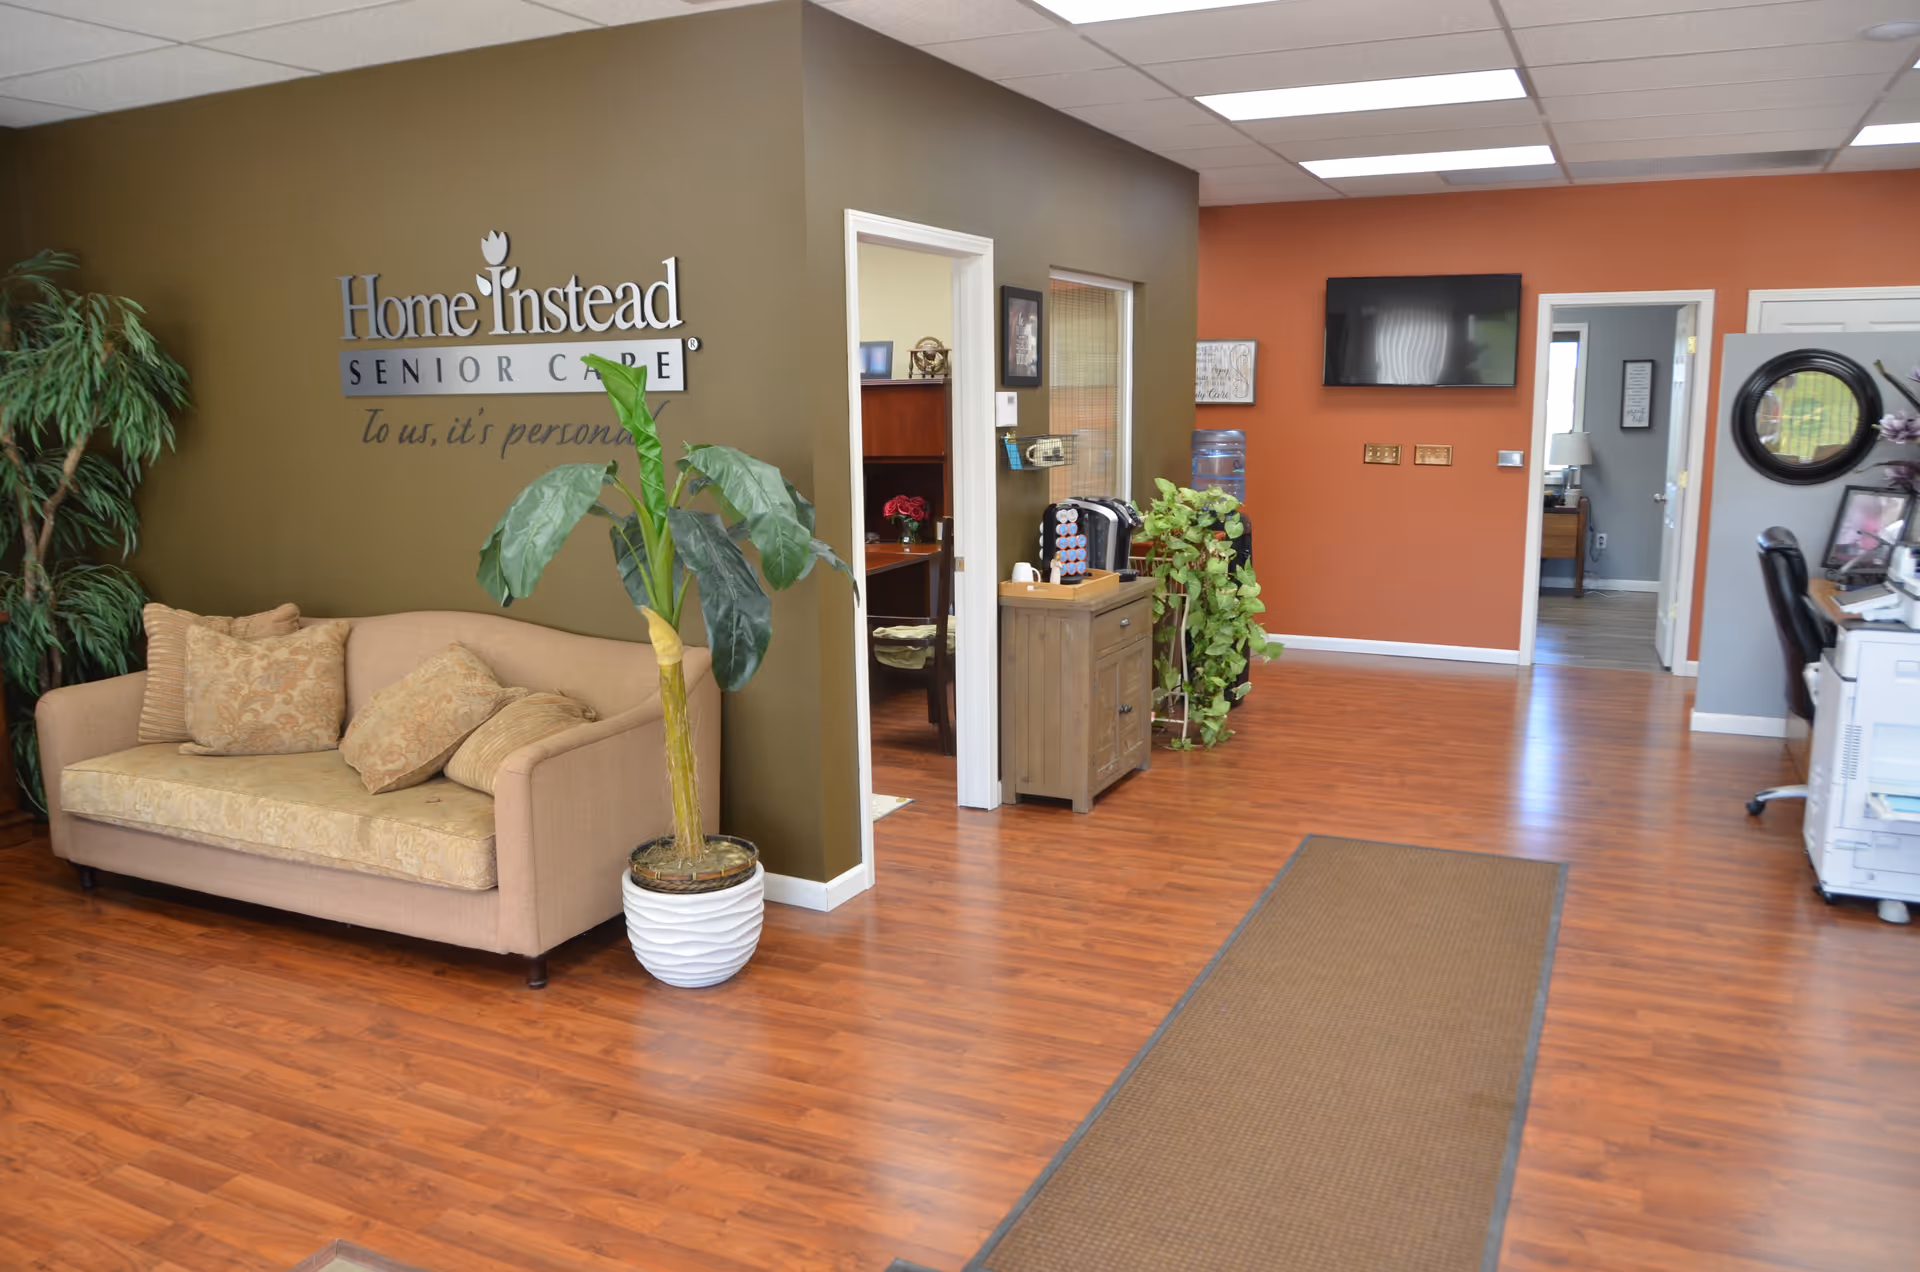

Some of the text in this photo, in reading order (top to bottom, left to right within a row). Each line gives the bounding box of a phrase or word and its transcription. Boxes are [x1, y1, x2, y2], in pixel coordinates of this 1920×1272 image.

[336, 255, 684, 340] Home Instead
[350, 355, 514, 385] SENIOR
[362, 408, 390, 443] To
[398, 423, 437, 447] us,
[446, 406, 494, 445] it's
